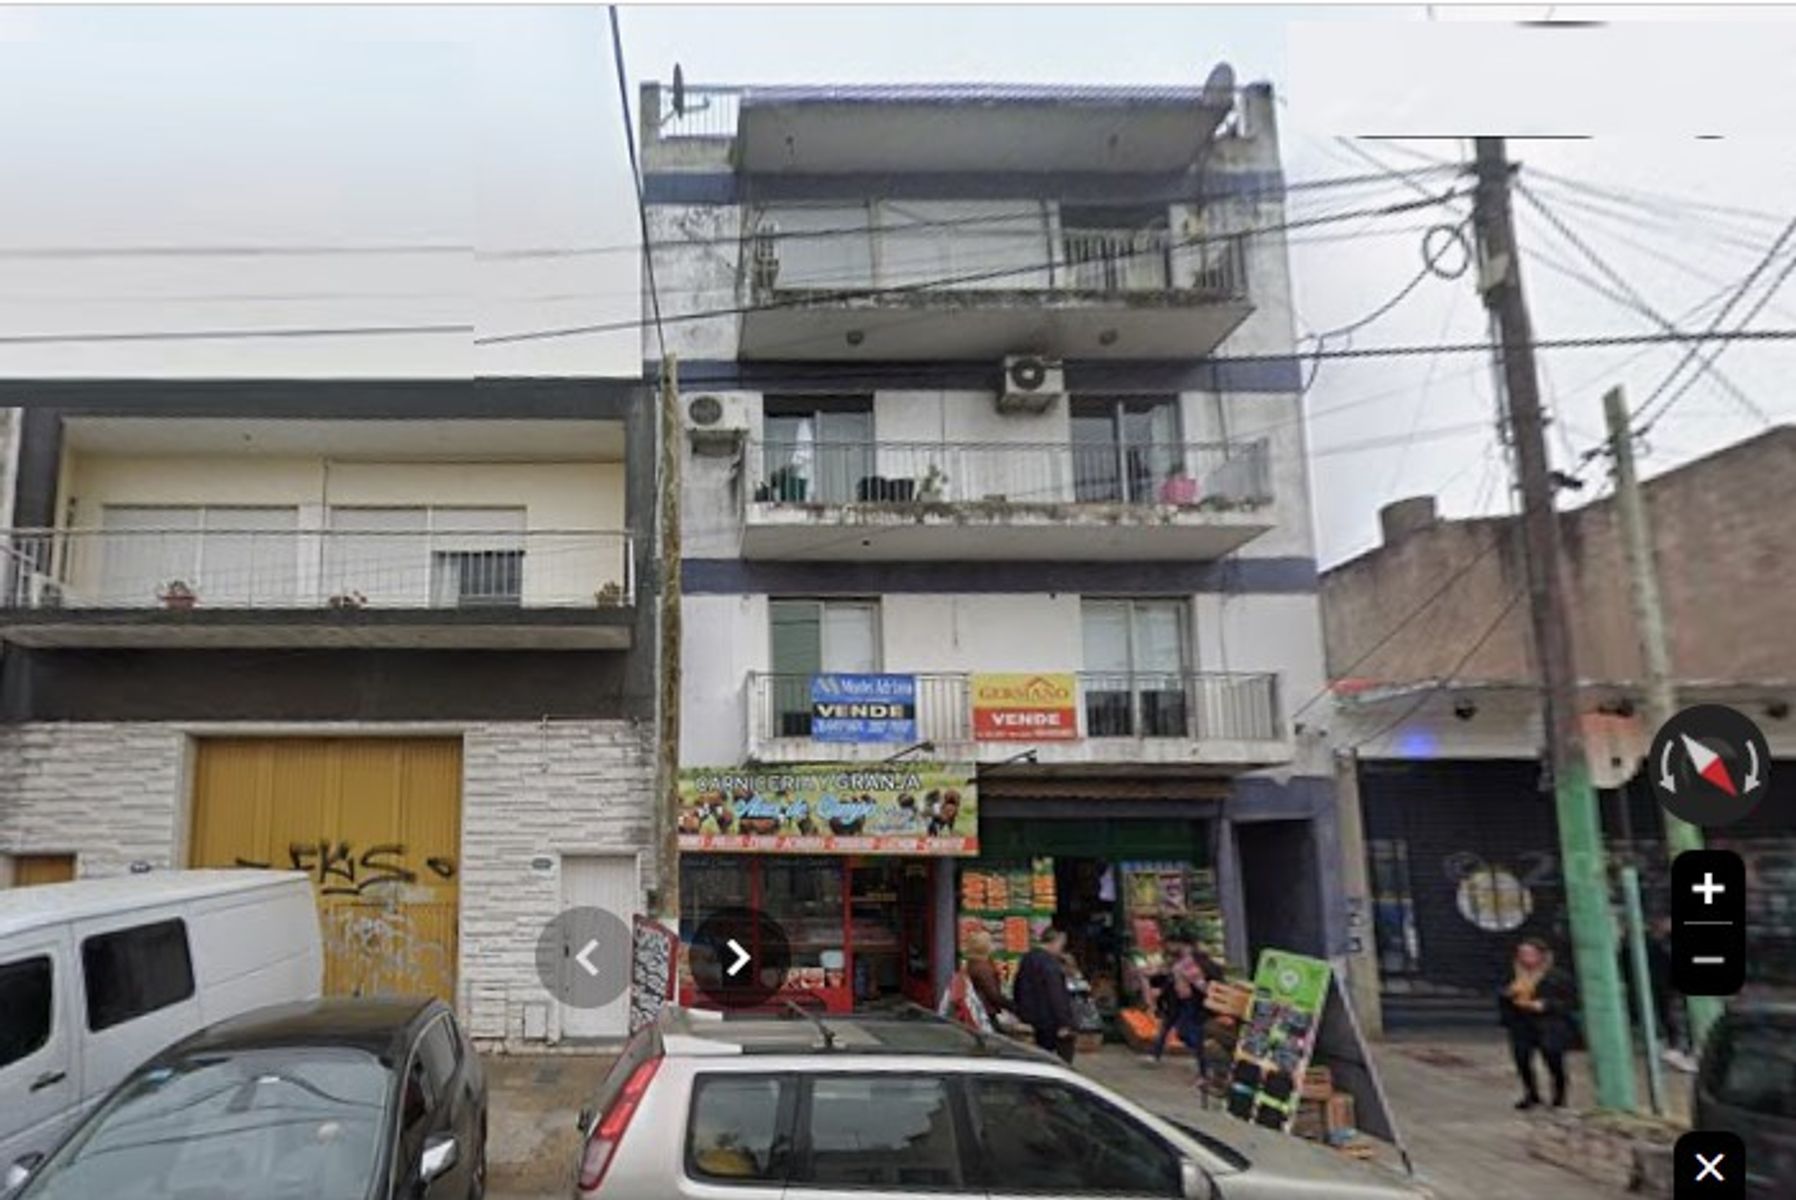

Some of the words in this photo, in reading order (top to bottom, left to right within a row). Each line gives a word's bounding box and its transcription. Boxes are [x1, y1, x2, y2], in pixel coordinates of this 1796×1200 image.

[816, 703, 905, 719] VENDE
[990, 711, 1062, 727] VENDE
[835, 772, 921, 791] GRANJA
